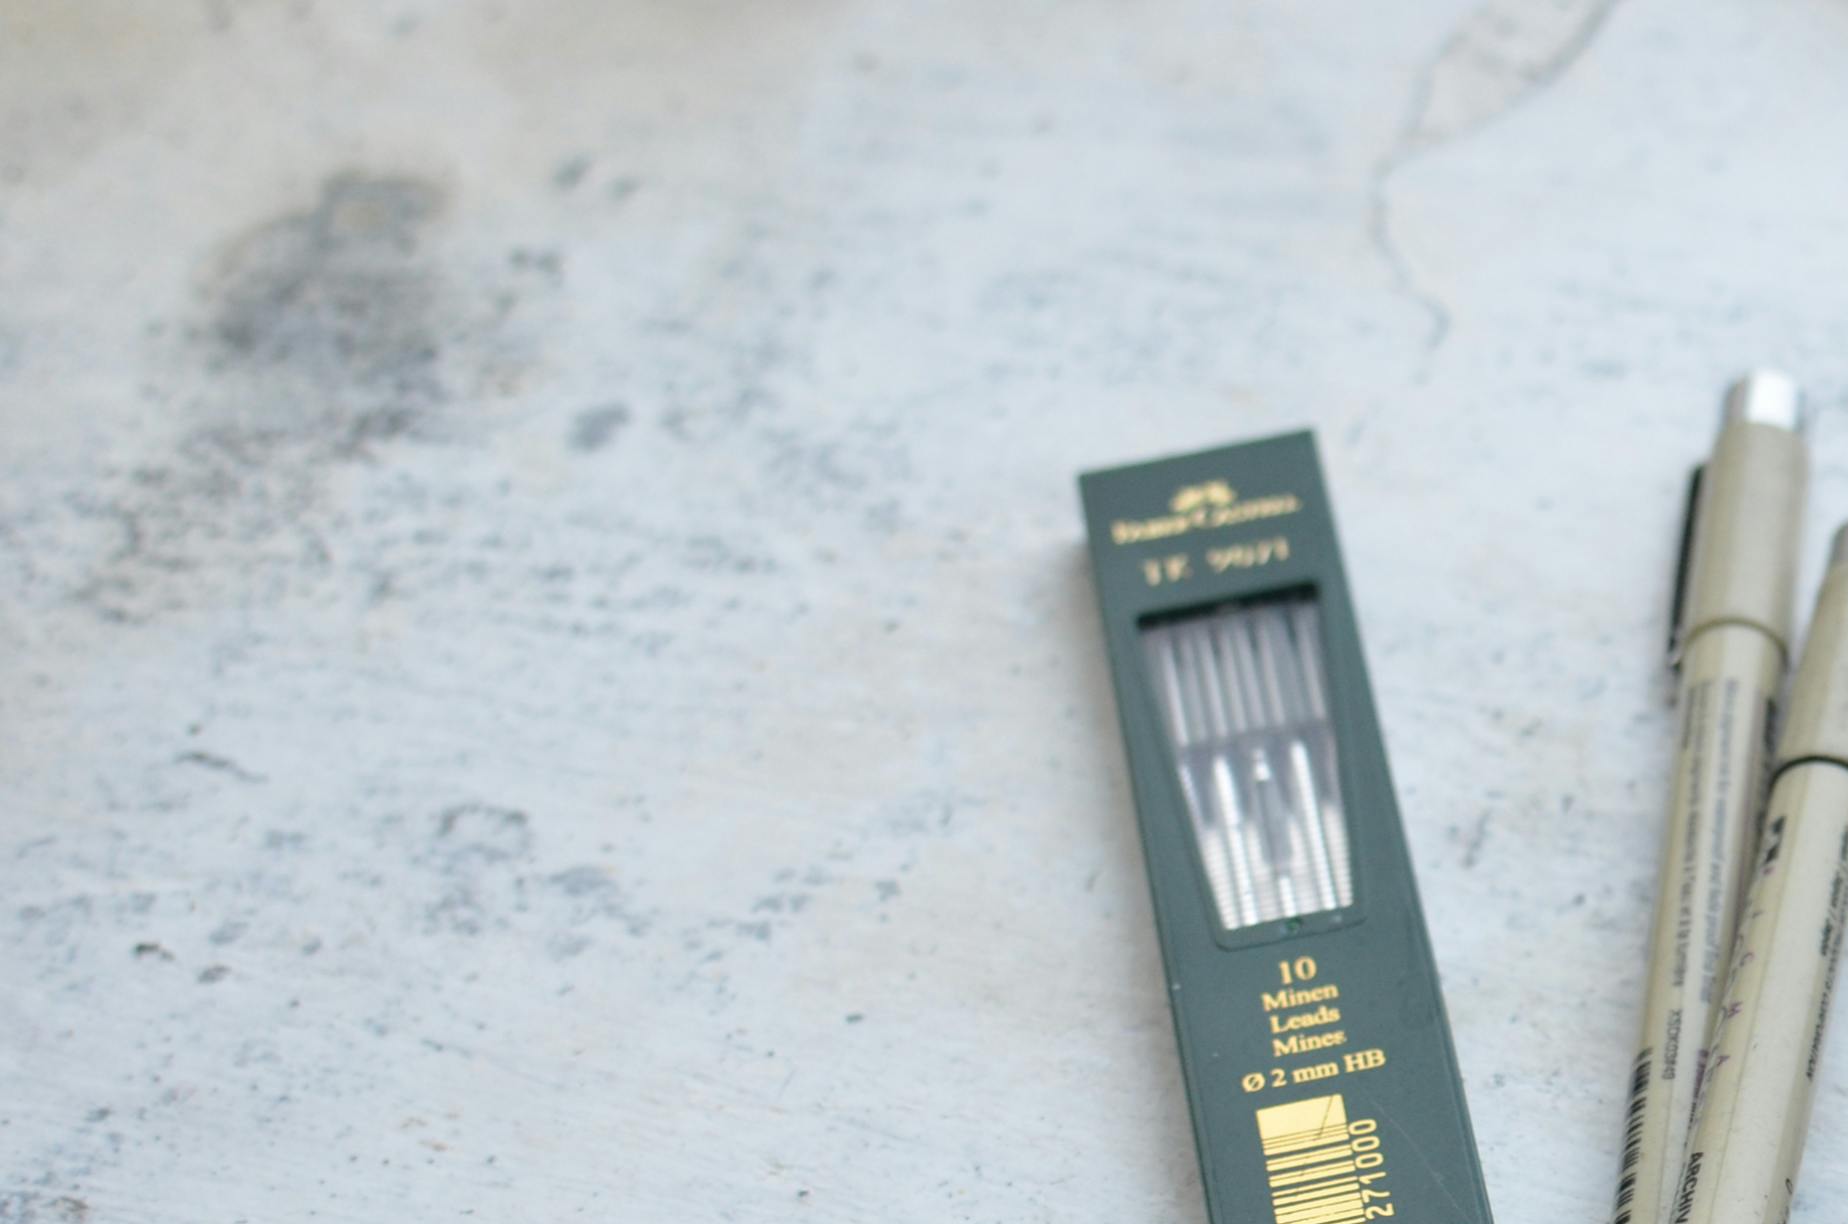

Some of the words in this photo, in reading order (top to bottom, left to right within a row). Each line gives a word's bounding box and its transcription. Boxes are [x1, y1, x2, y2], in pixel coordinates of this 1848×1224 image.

[1277, 953, 1319, 985] 10
[1259, 980, 1339, 1012] Minen
[1268, 1002, 1342, 1033] Leads
[1270, 1026, 1347, 1057] Mines
[1269, 1066, 1287, 1088] 2
[1291, 1061, 1339, 1083] mm
[1341, 1046, 1386, 1073] HB
[1348, 1119, 1395, 1221] 271000
